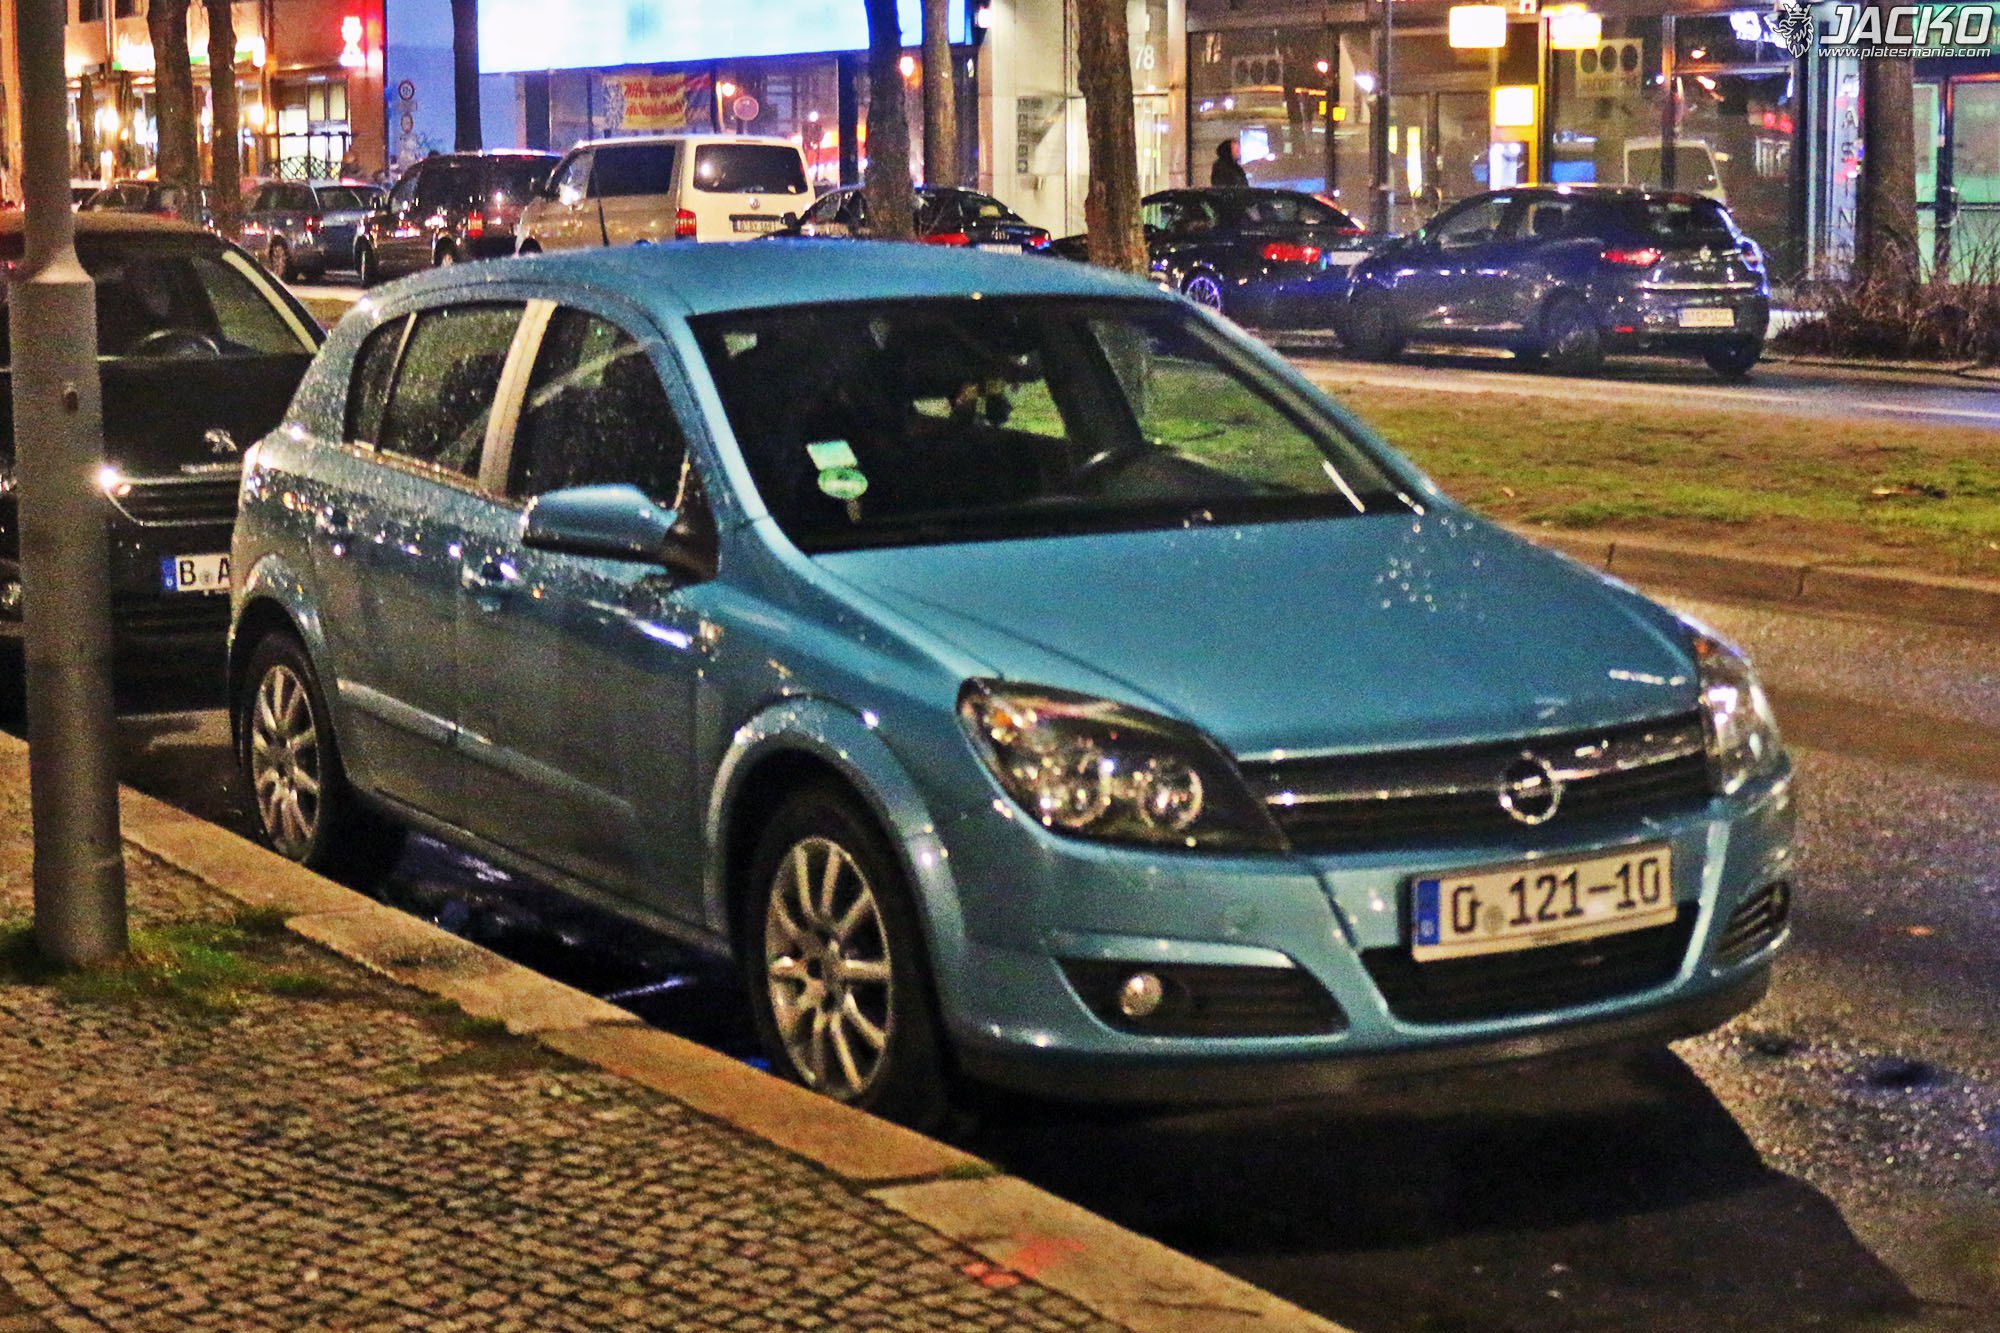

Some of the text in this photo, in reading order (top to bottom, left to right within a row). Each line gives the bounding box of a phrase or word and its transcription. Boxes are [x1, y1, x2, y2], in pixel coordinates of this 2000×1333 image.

[1134, 44, 1155, 70] 78
[180, 559, 197, 586] B
[1508, 857, 1661, 926] 121-10
